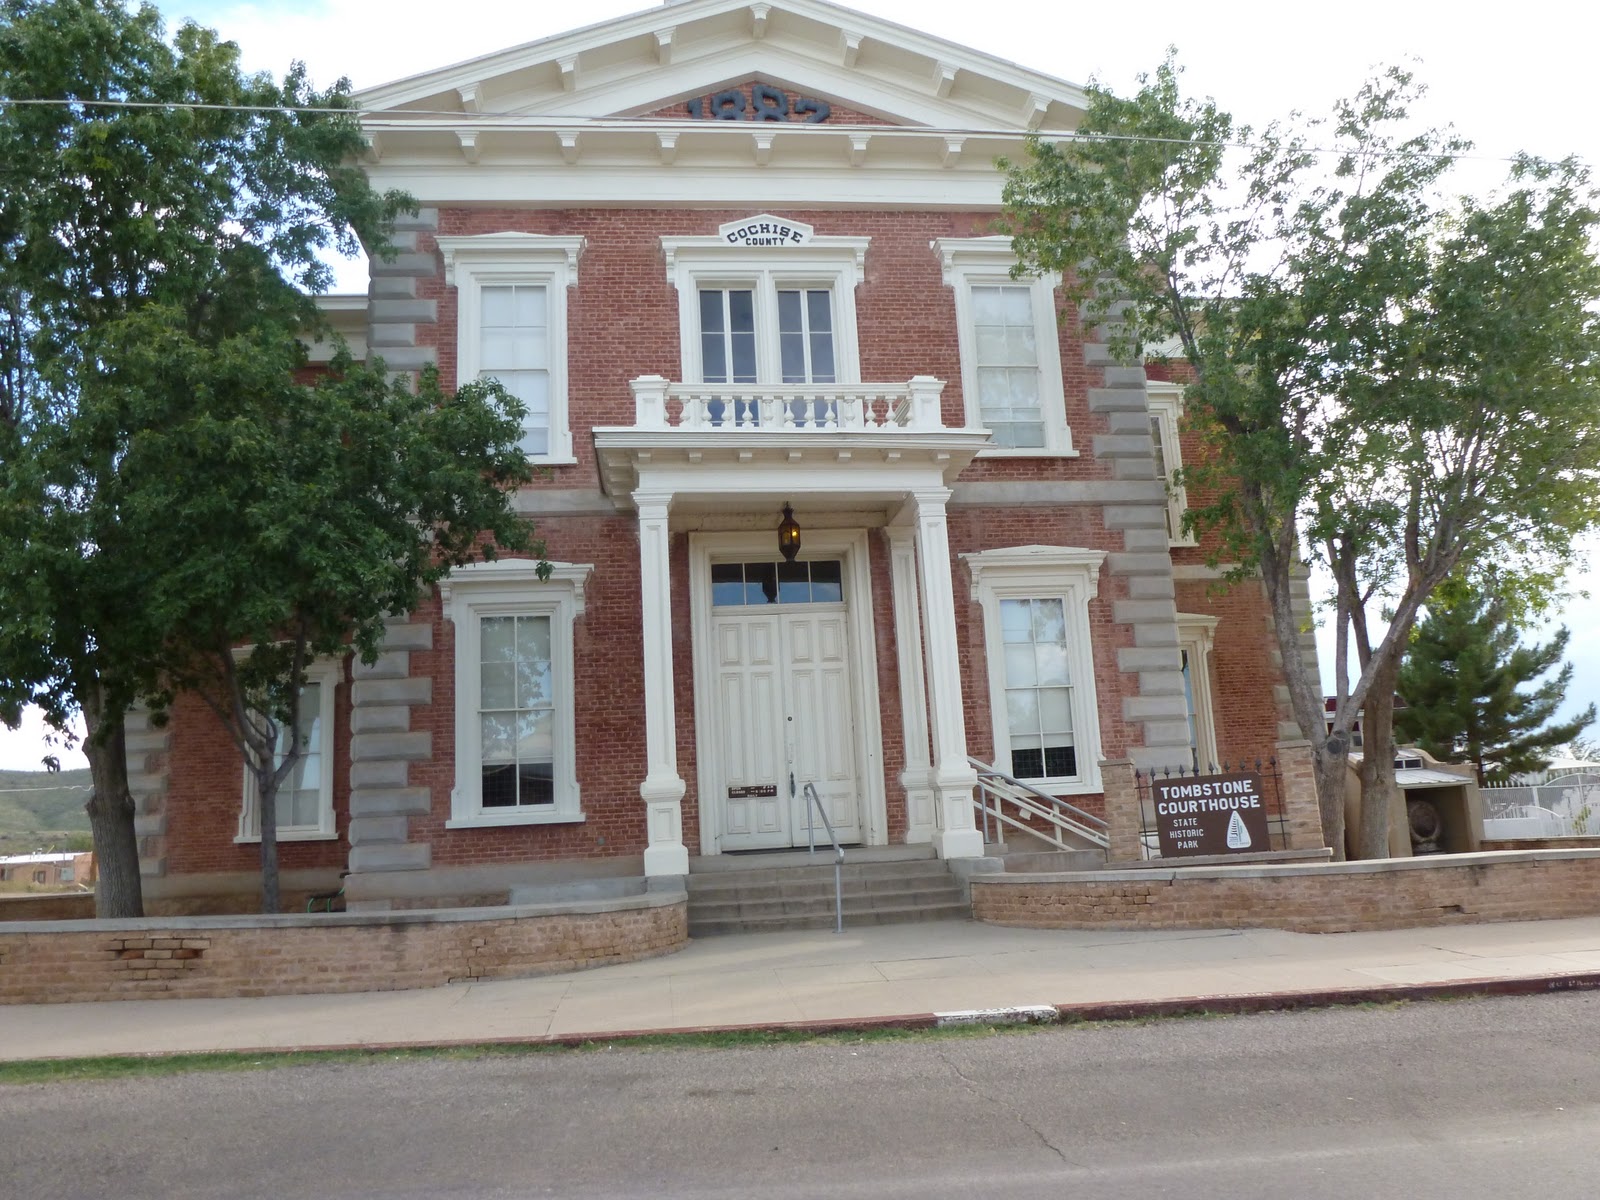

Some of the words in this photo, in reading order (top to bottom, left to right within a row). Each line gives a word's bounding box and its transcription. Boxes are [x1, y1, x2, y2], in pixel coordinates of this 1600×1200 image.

[726, 223, 803, 243] COCHISE
[745, 237, 785, 246] COUNTY
[1160, 780, 1253, 799] TOMBSTONE
[1158, 795, 1261, 815] COURTHOUSE
[1173, 818, 1198, 827] STATE
[1169, 829, 1204, 839] HISTORIC
[1177, 840, 1199, 849] PARK
